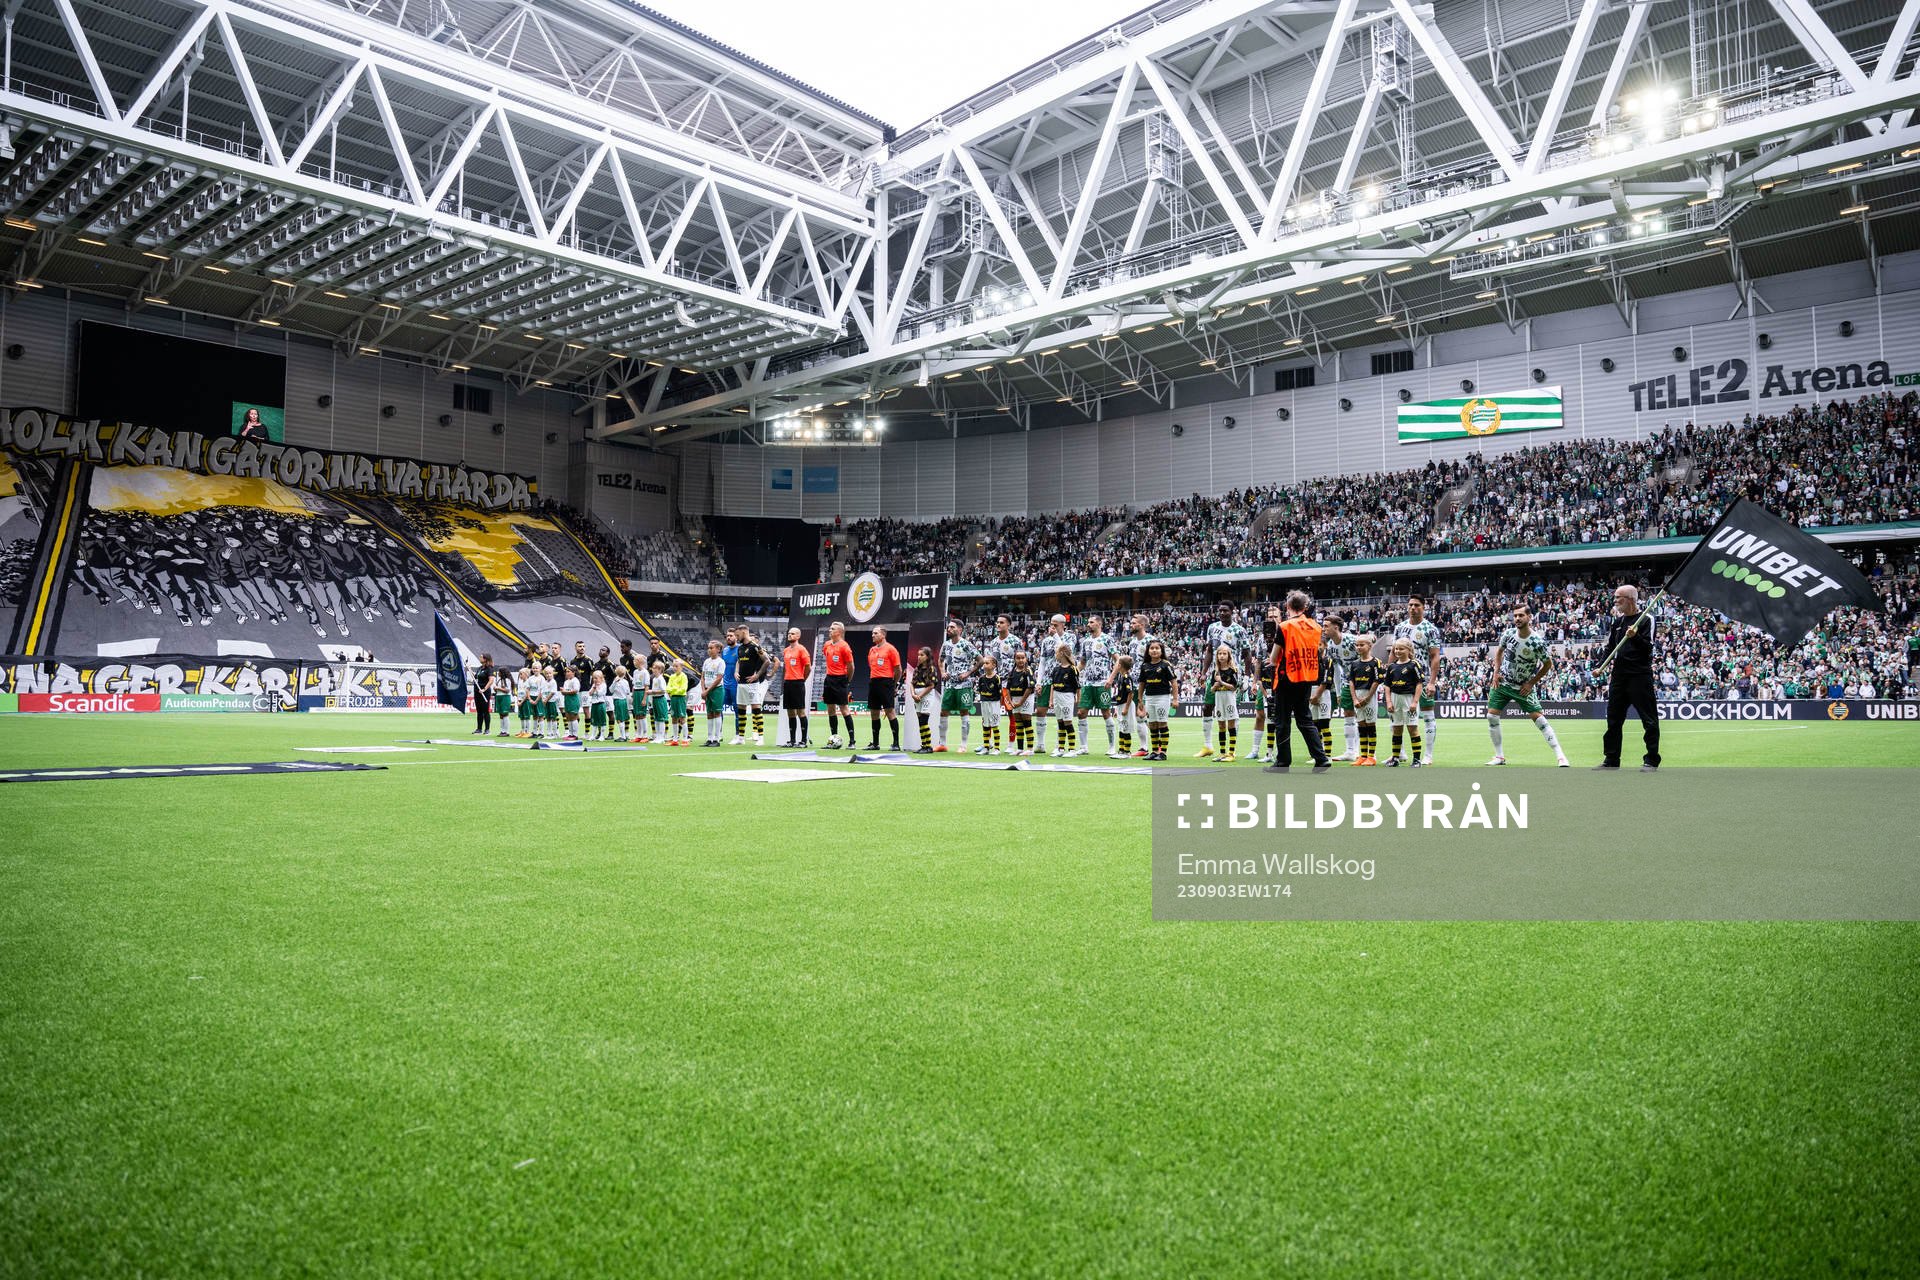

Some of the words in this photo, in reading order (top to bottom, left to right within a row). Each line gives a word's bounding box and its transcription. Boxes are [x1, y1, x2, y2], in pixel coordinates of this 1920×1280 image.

[1628, 358, 1750, 411] TELE2
[1759, 360, 1893, 398] Arena
[1895, 373, 1920, 386] LOF
[111, 422, 203, 471] KAN
[597, 473, 632, 490] TELE2
[634, 479, 666, 495] Arena
[1708, 526, 1842, 598] UNIBET
[799, 592, 840, 608] UNIBET
[892, 584, 939, 600] UNIBET
[49, 694, 135, 712] Scandic
[165, 697, 250, 708] AudicomPendax
[340, 696, 384, 707] PROJOB
[1440, 705, 1489, 718] UNIBE
[1657, 703, 1792, 720] STOCKHOLM
